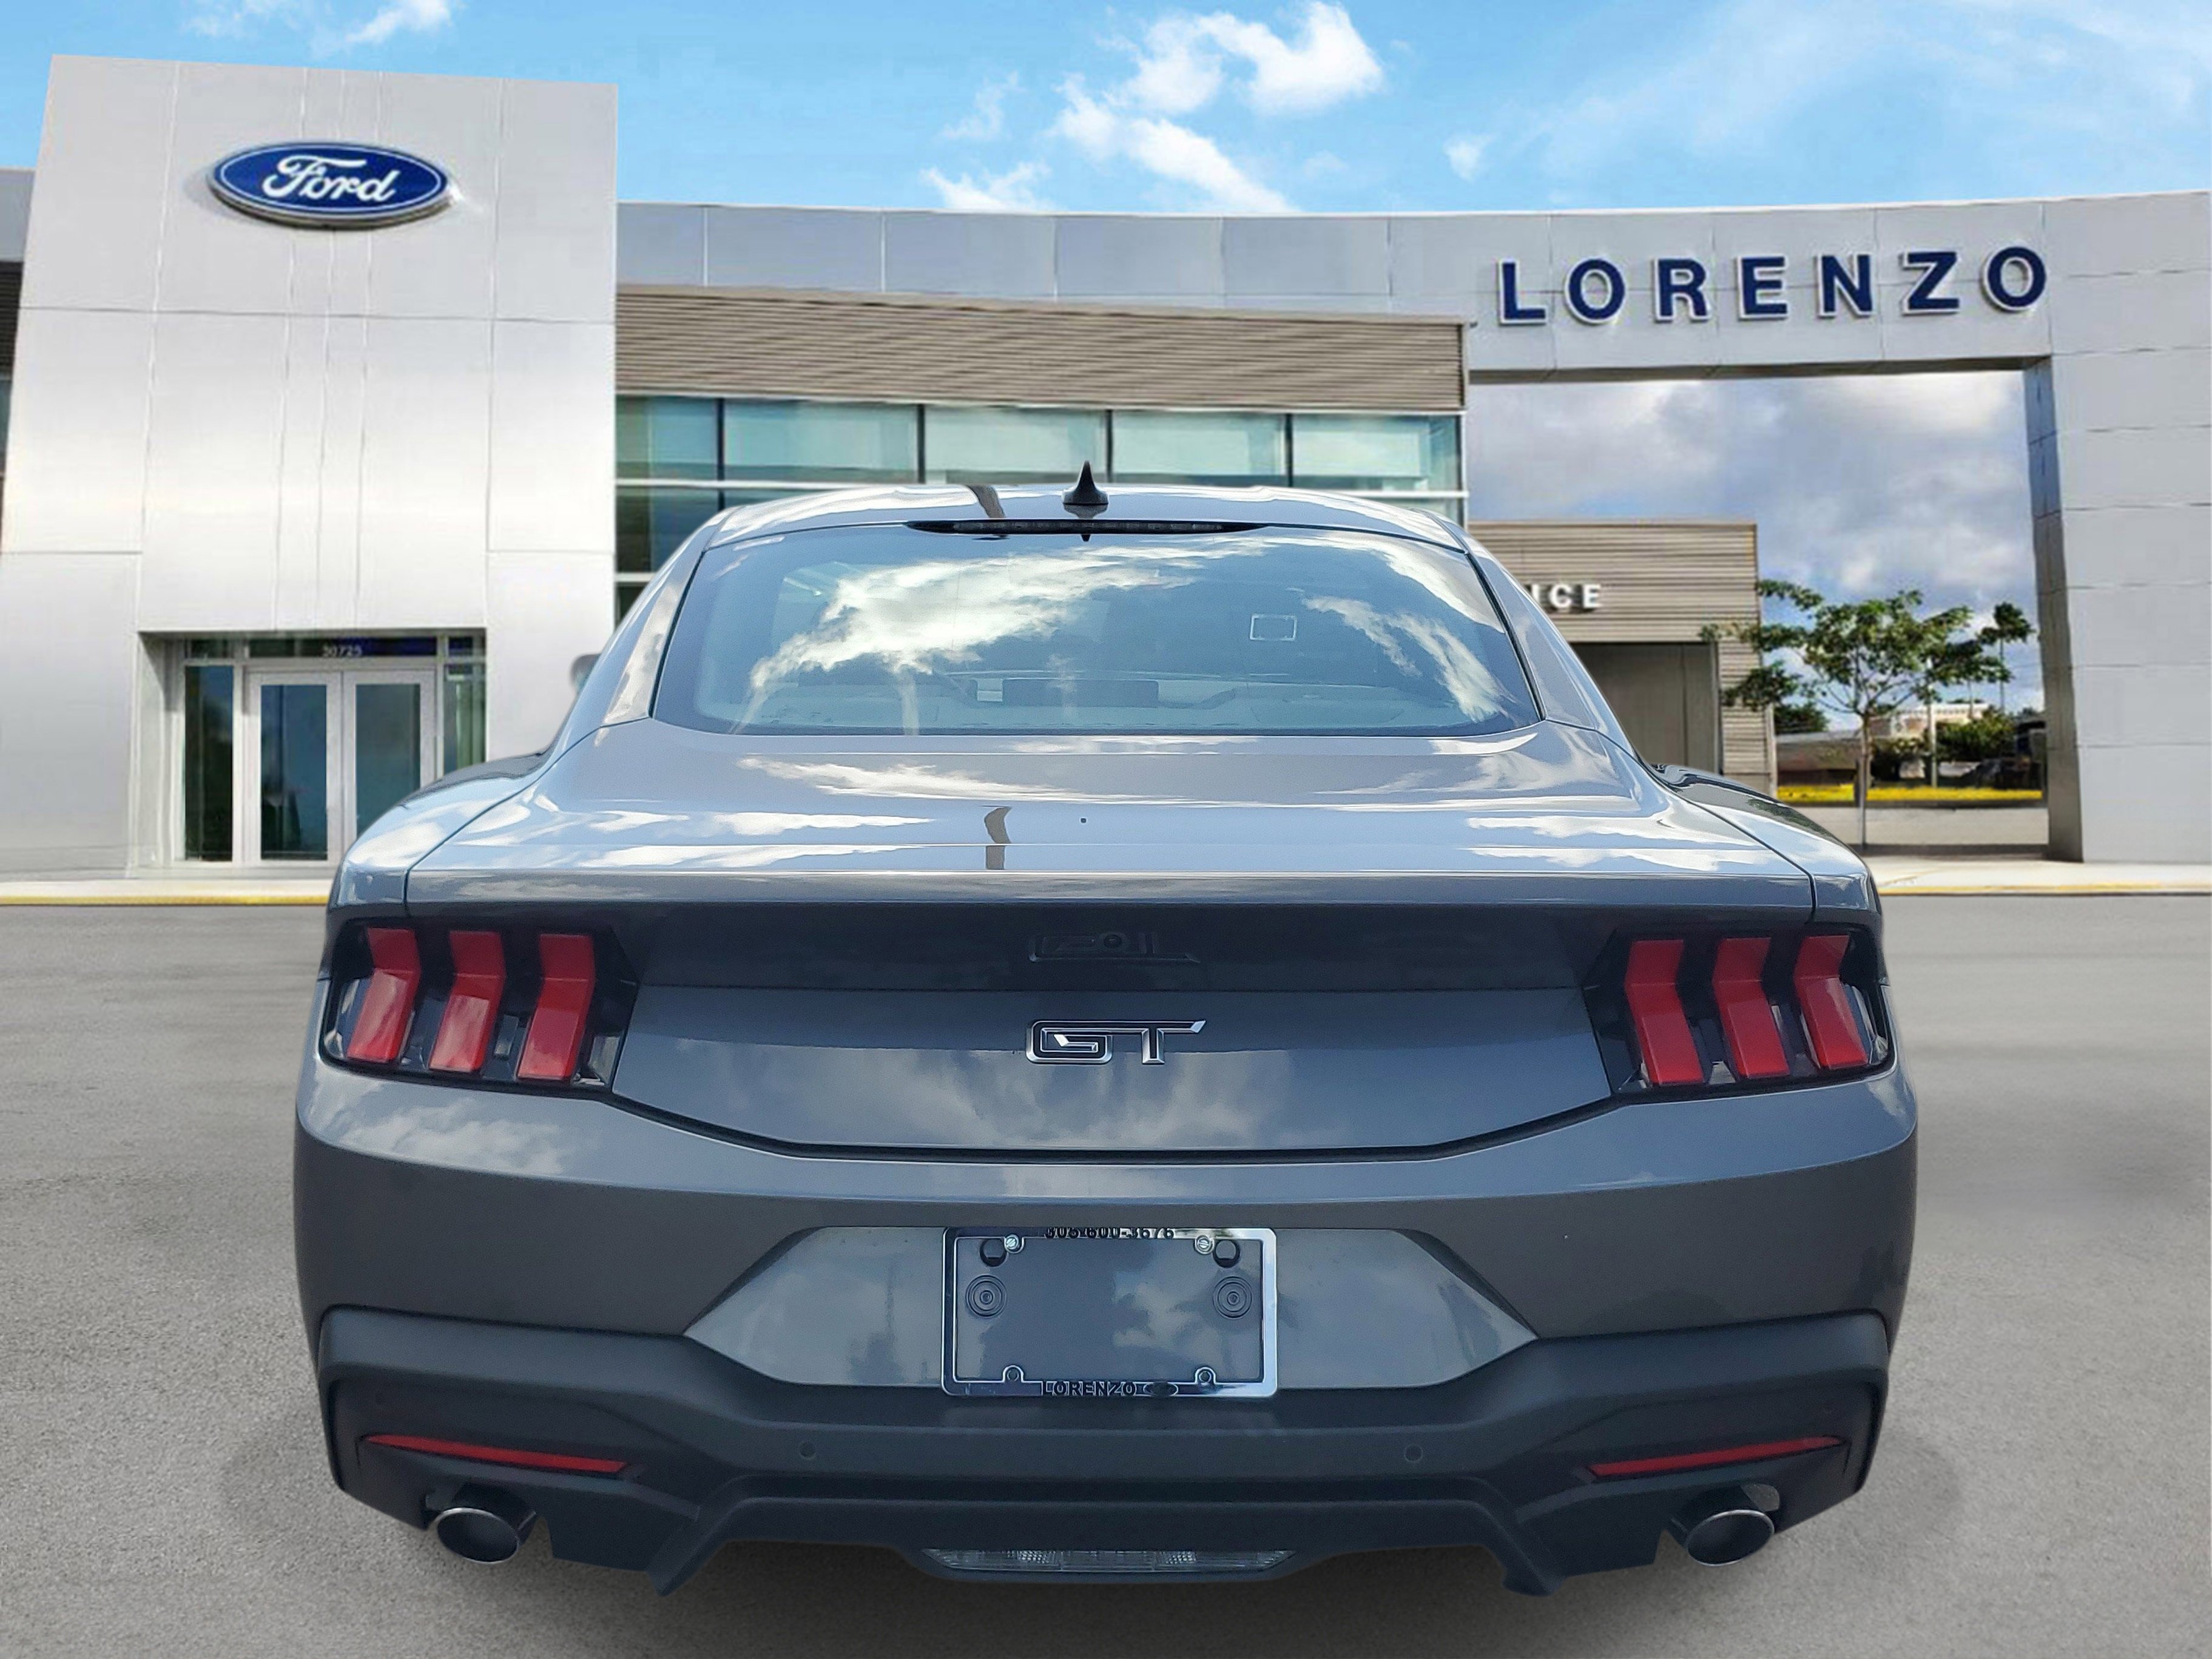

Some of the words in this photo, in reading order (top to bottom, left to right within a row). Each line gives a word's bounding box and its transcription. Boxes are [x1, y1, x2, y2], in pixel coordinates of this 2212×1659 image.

[262, 155, 400, 201] Ford
[1497, 246, 2048, 325] LORENZO
[1026, 1019, 1207, 1066] GT
[1042, 1380, 1137, 1396] LORENZO
